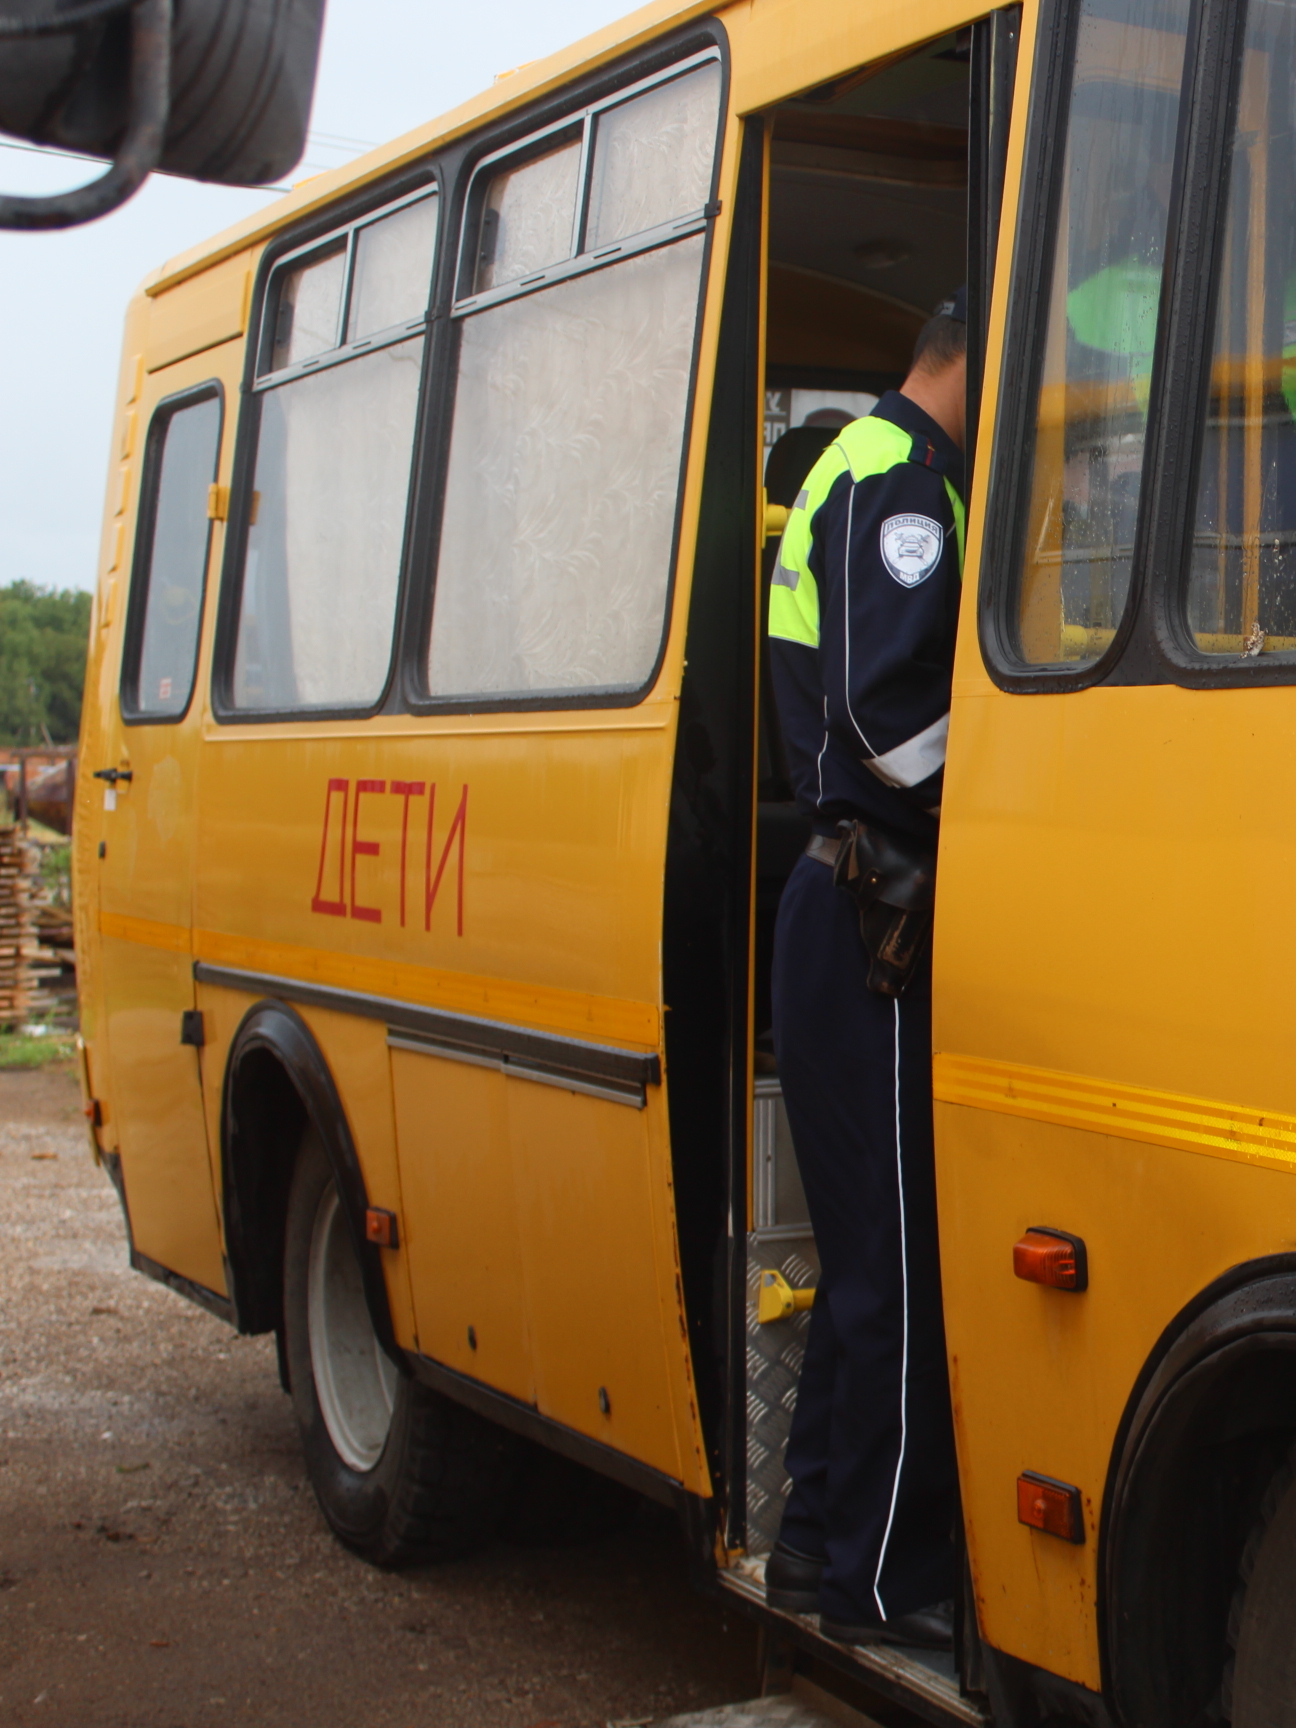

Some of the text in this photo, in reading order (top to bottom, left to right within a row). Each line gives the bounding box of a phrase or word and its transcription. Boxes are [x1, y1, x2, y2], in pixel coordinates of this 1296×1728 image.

[886, 517, 939, 535] ПОЛИЦИЯ
[899, 571, 920, 583] МВД
[310, 777, 469, 938] ДЕТИ
